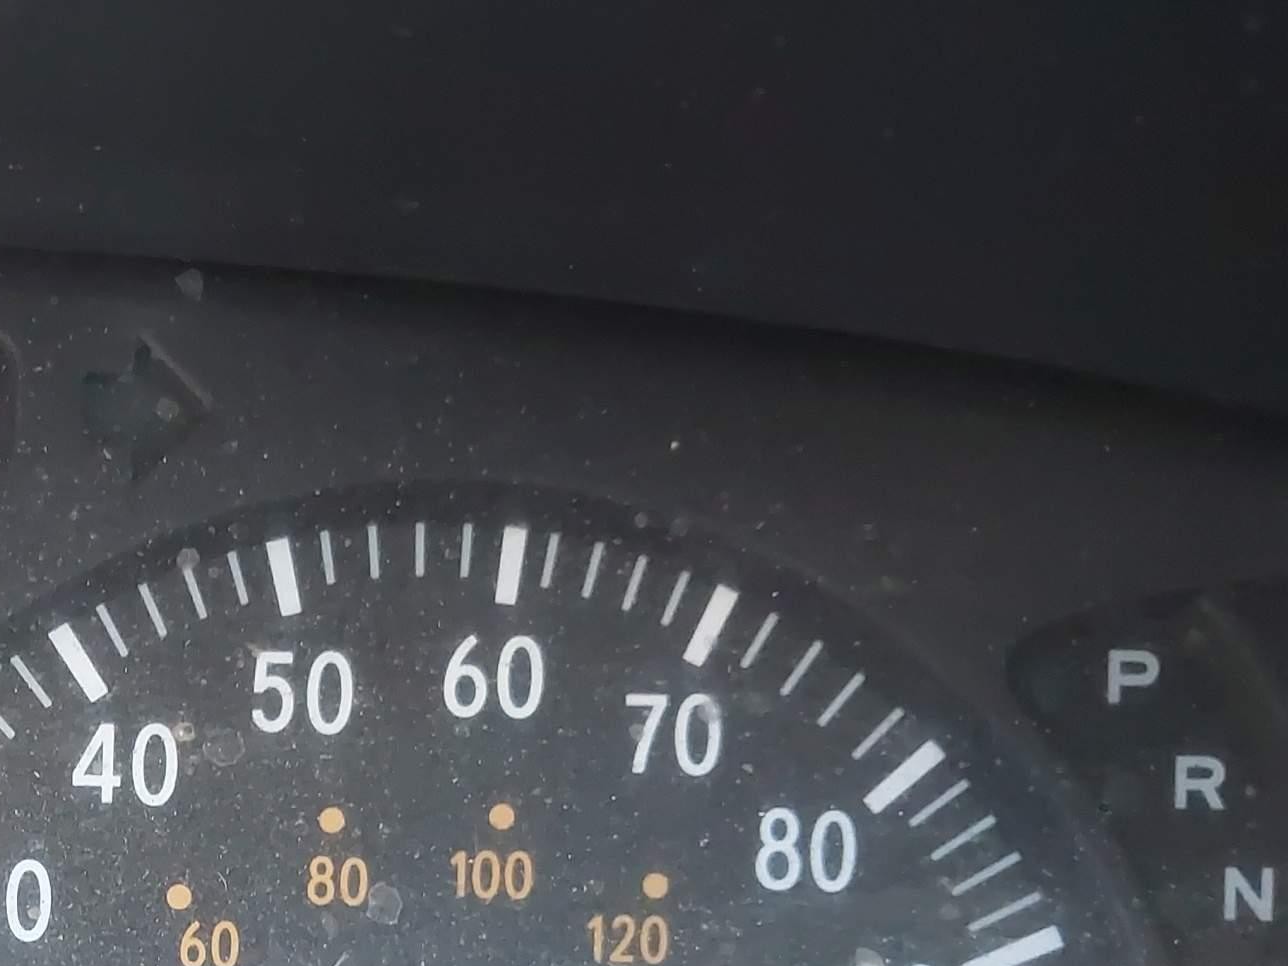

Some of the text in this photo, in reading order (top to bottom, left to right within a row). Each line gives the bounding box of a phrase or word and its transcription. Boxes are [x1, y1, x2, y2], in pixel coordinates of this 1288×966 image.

[250, 650, 355, 736] 50
[444, 634, 546, 720] 60
[1107, 649, 1160, 704] P
[624, 690, 724, 780] 70
[72, 720, 178, 808] 40
[1174, 755, 1226, 809] R
[450, 848, 534, 902] 100
[754, 806, 858, 894] 80
[306, 857, 370, 906] 80
[1224, 867, 1274, 922] N
[586, 914, 672, 966] 120
